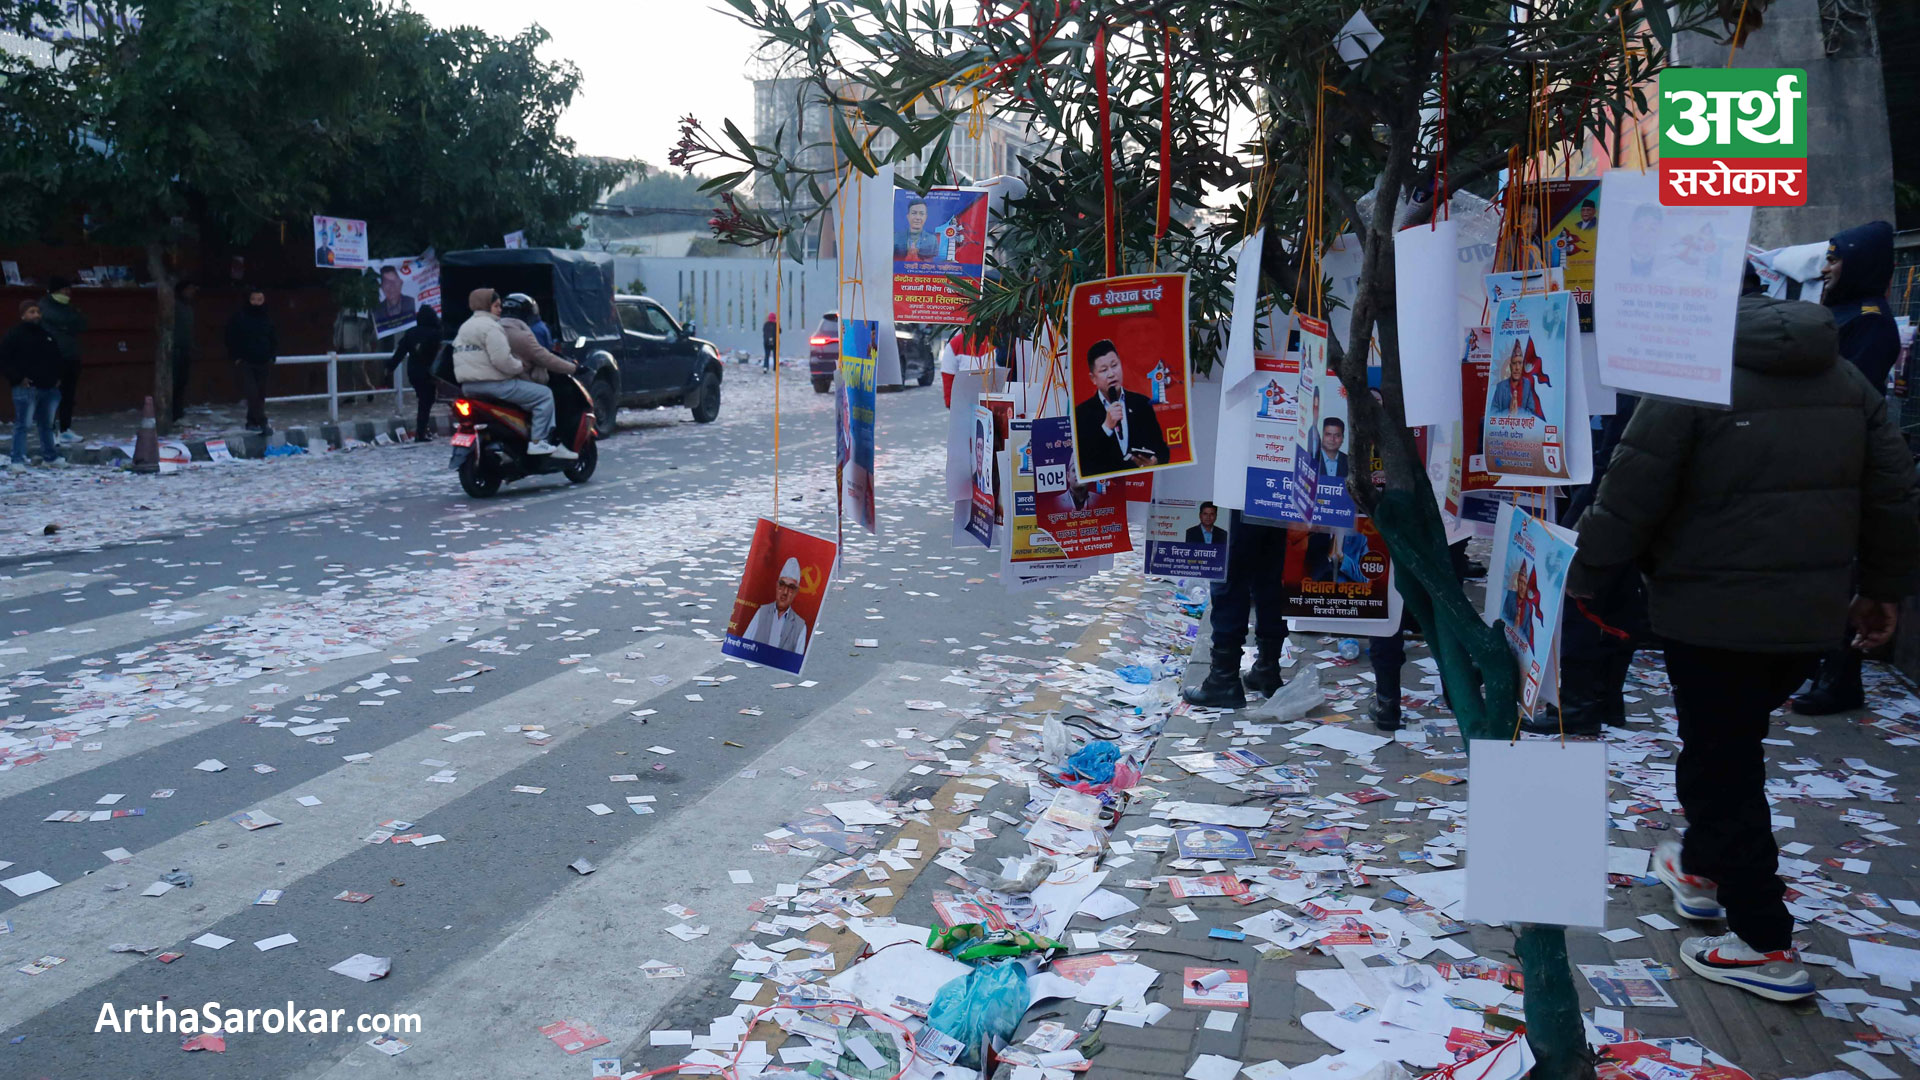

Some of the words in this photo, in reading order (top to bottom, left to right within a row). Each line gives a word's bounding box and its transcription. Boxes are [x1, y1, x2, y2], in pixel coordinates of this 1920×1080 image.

[1142, 284, 1163, 301] राई
[1361, 562, 1384, 573] १४७
[1301, 577, 1335, 594] विशाल
